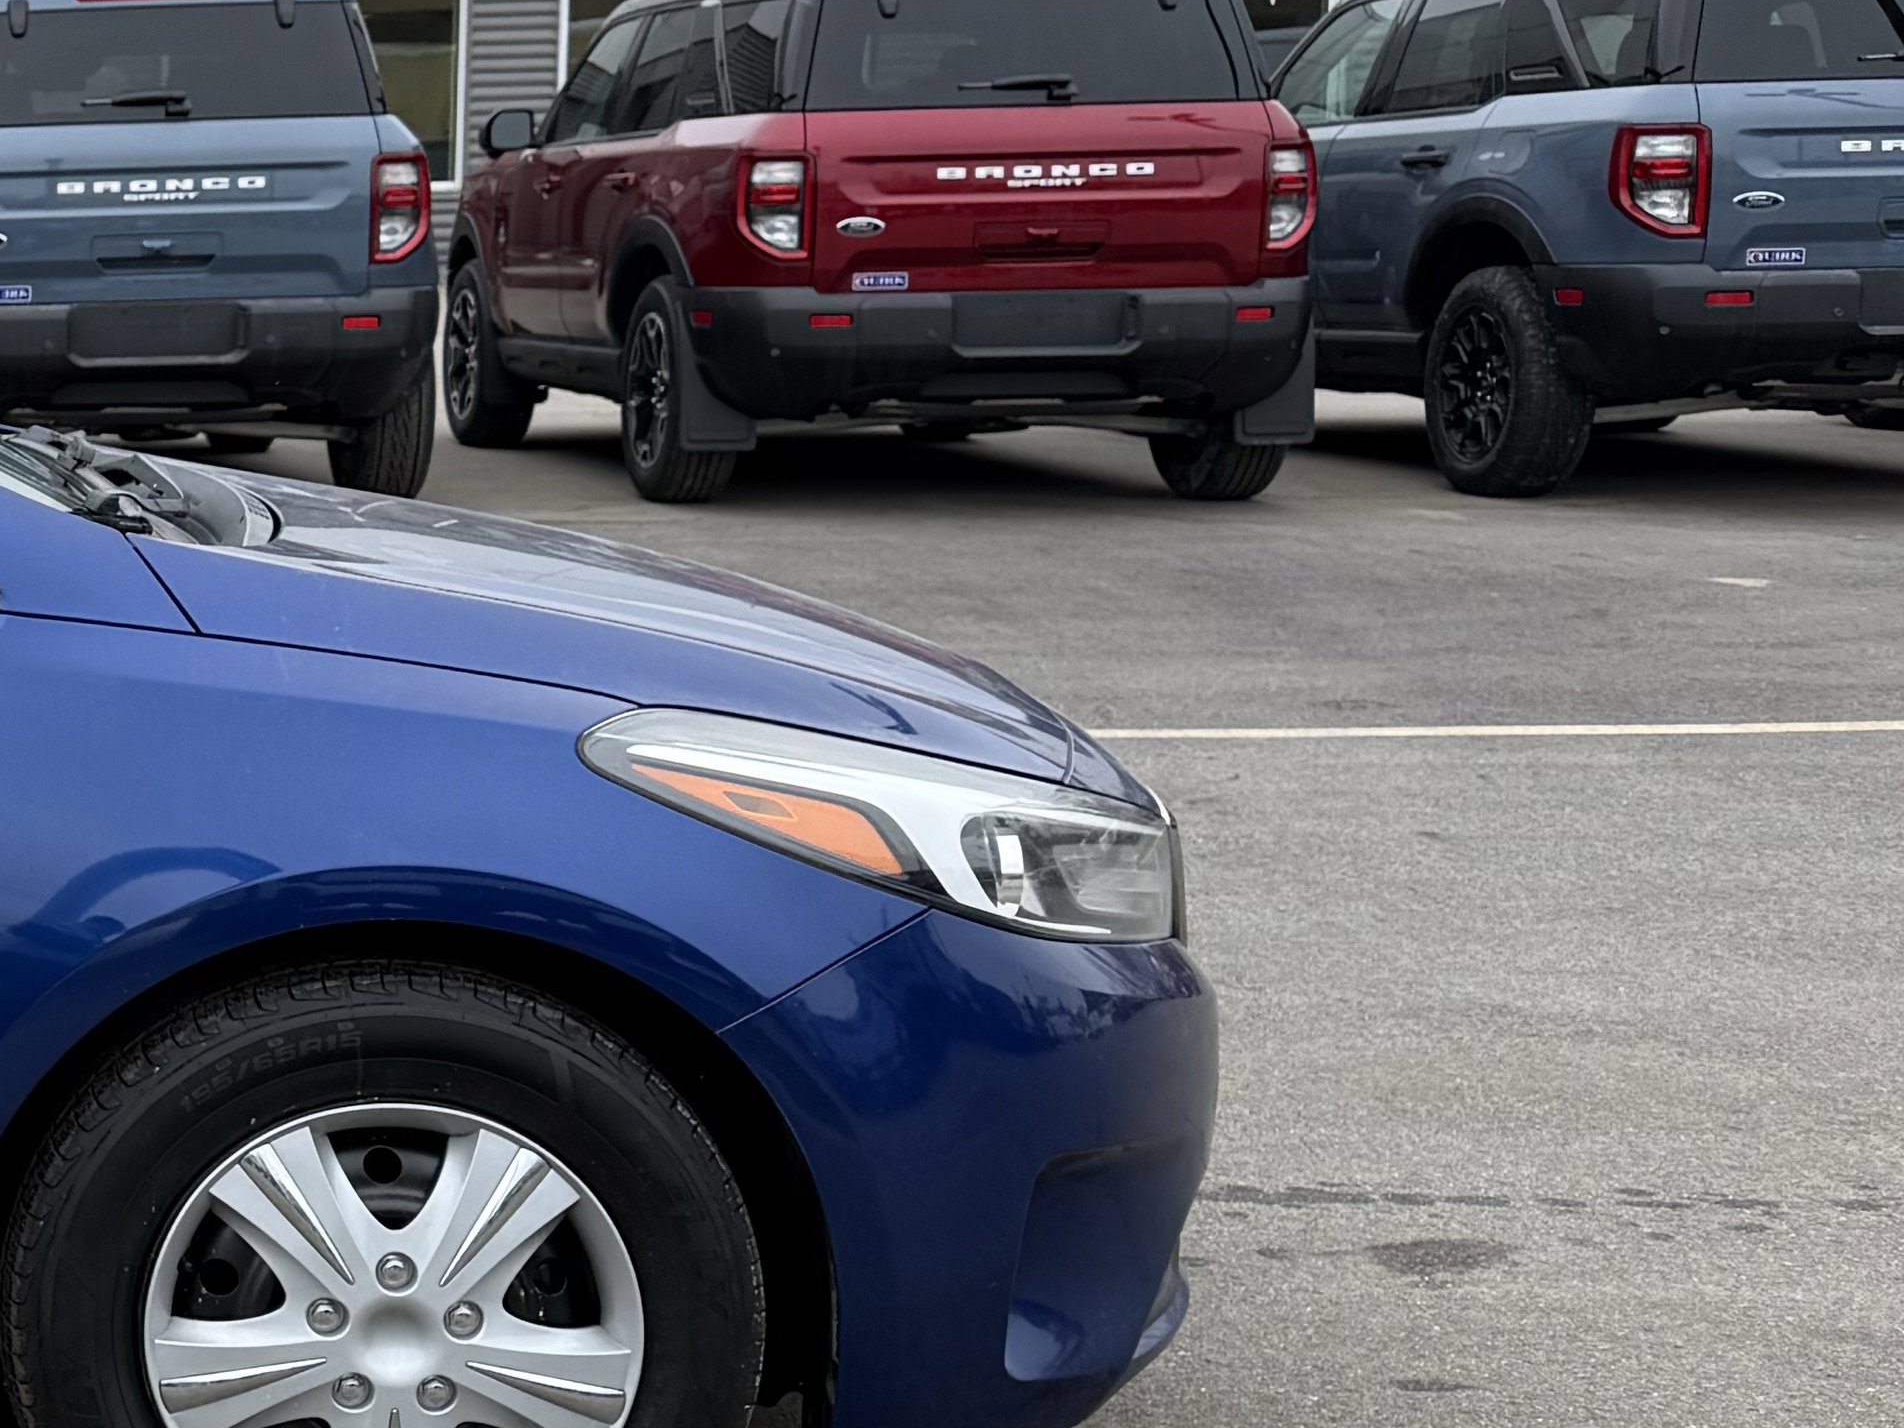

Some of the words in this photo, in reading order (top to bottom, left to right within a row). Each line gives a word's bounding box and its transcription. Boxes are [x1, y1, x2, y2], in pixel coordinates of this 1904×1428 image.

[937, 162, 1154, 180] BRONCO
[57, 176, 266, 194] BRONCO
[1749, 250, 1802, 263] QUIRK
[178, 1030, 362, 1113] 195/65R15
